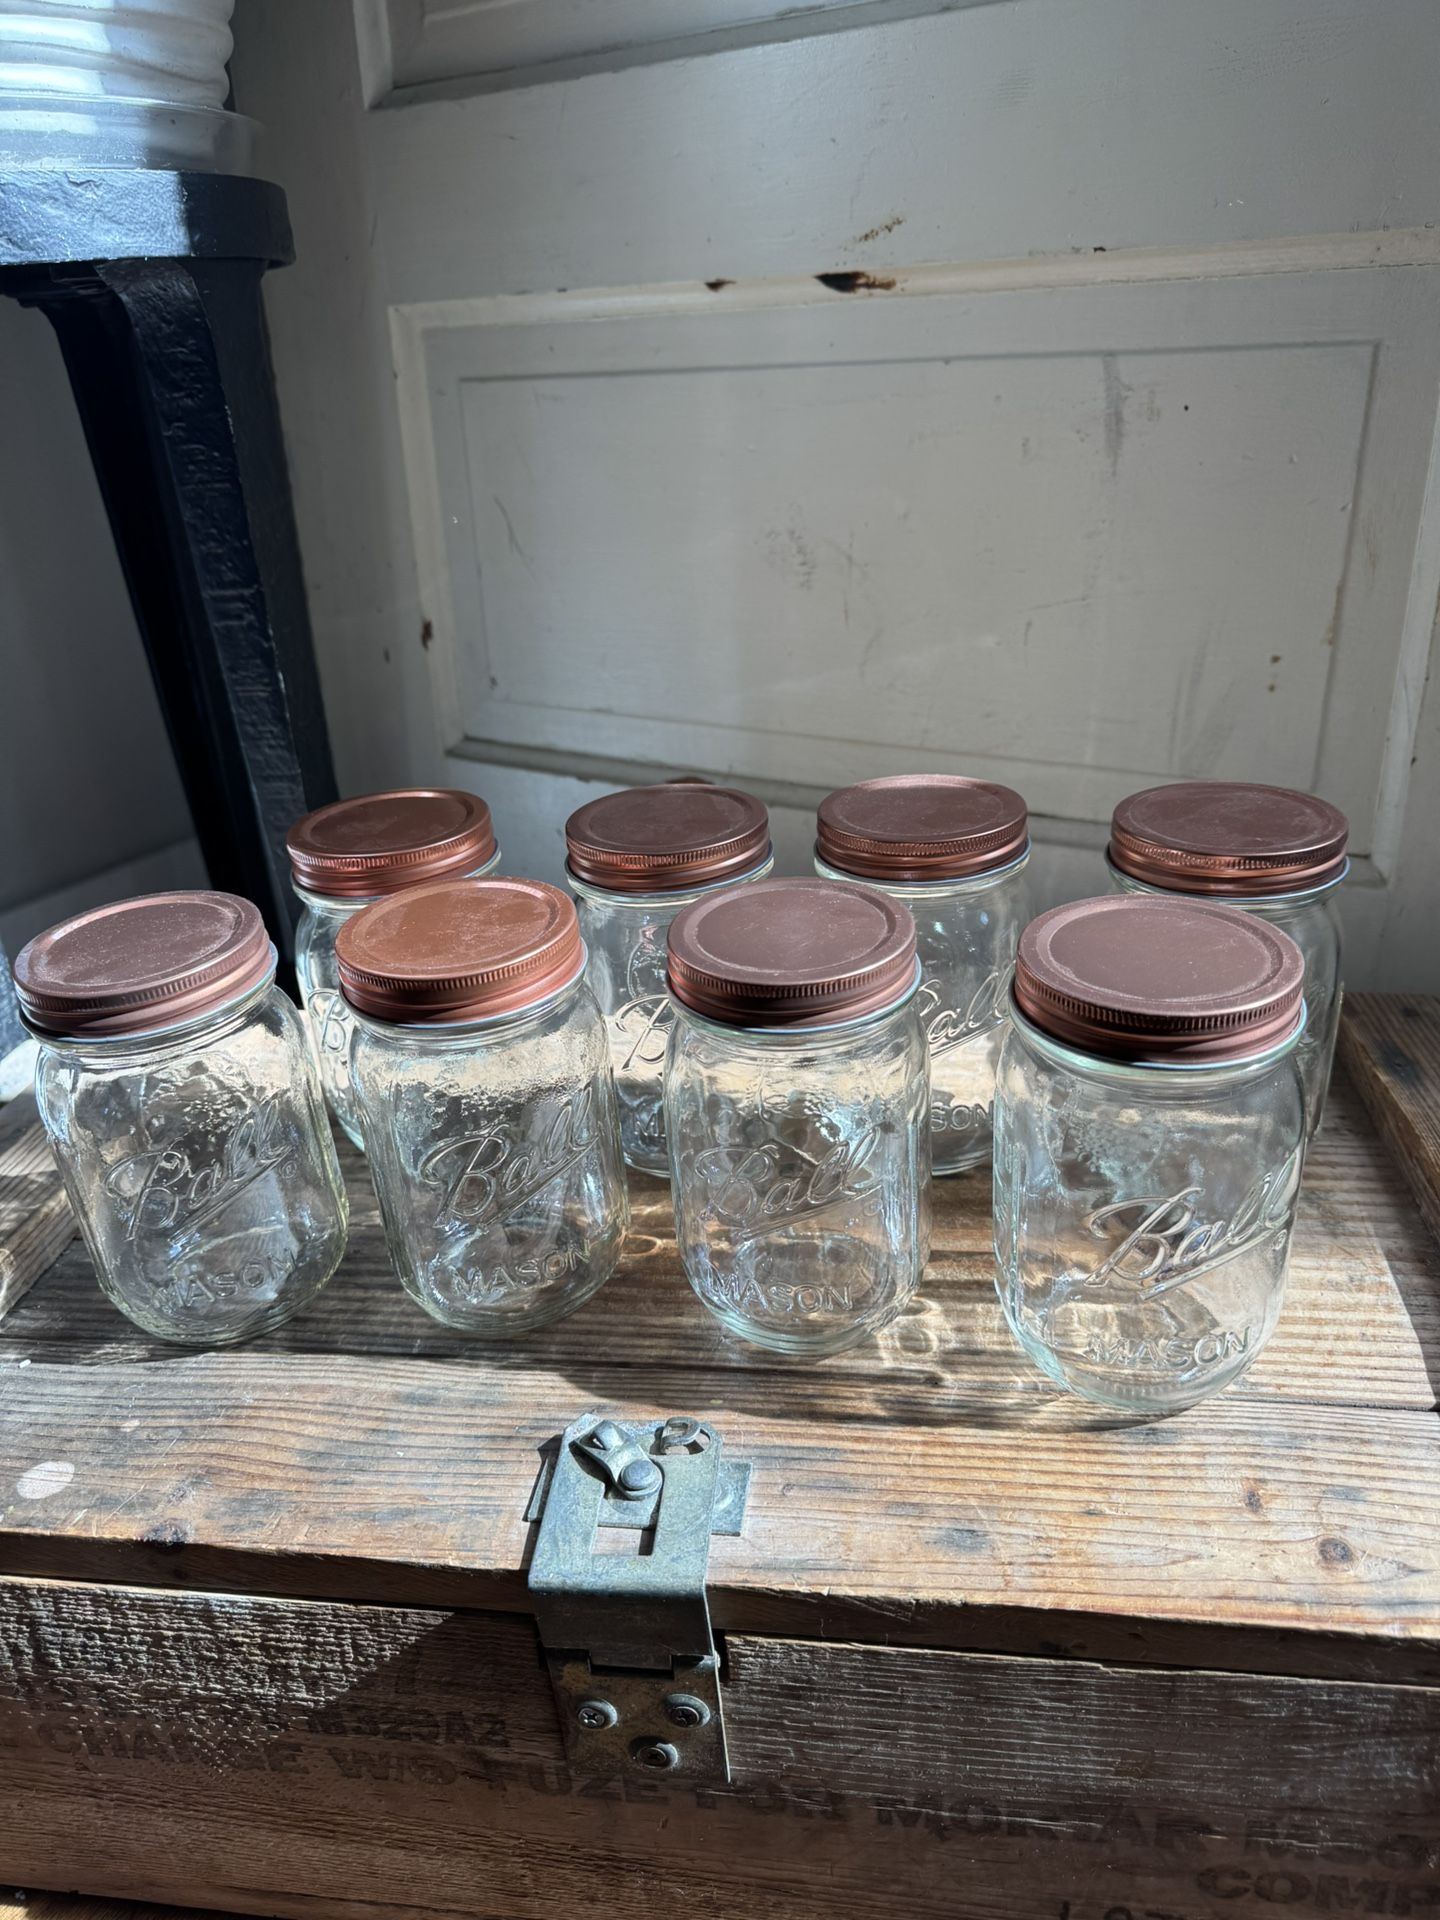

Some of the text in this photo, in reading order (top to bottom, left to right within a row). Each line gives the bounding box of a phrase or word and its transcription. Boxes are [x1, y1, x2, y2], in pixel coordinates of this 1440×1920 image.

[102, 1096, 292, 1243] Ball
[417, 1082, 600, 1229] Ball
[694, 1124, 890, 1238] Ball
[447, 1239, 593, 1305] MASON
[1084, 1146, 1300, 1300] Ball
[709, 1261, 853, 1315] MASON
[1085, 1326, 1251, 1369] MASON
